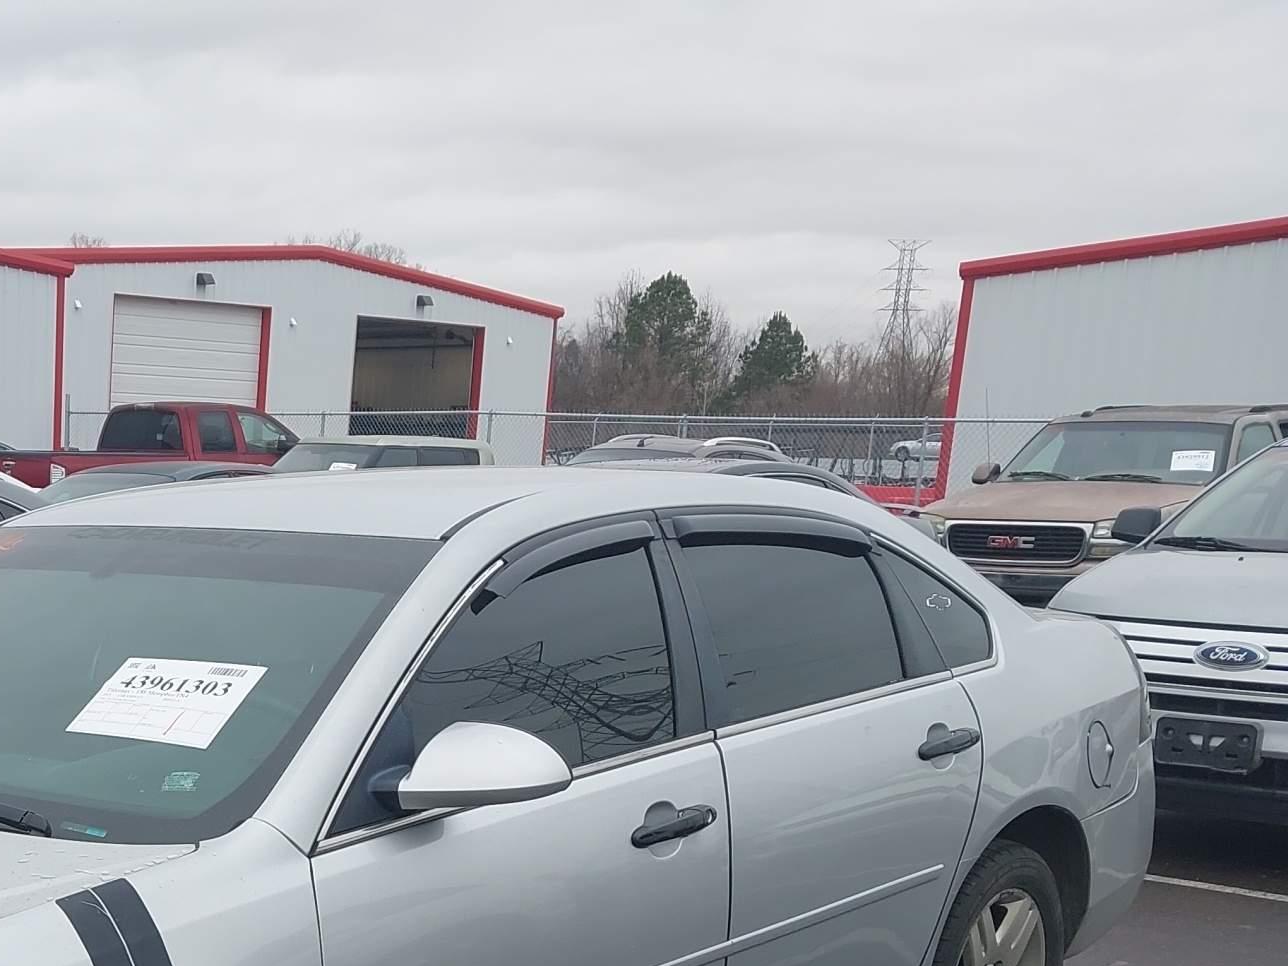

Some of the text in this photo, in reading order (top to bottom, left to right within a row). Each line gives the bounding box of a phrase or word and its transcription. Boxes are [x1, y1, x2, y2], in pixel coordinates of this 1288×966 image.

[987, 535, 1035, 549] GMC
[1209, 646, 1248, 662] Ford
[120, 674, 233, 697] 43961303
